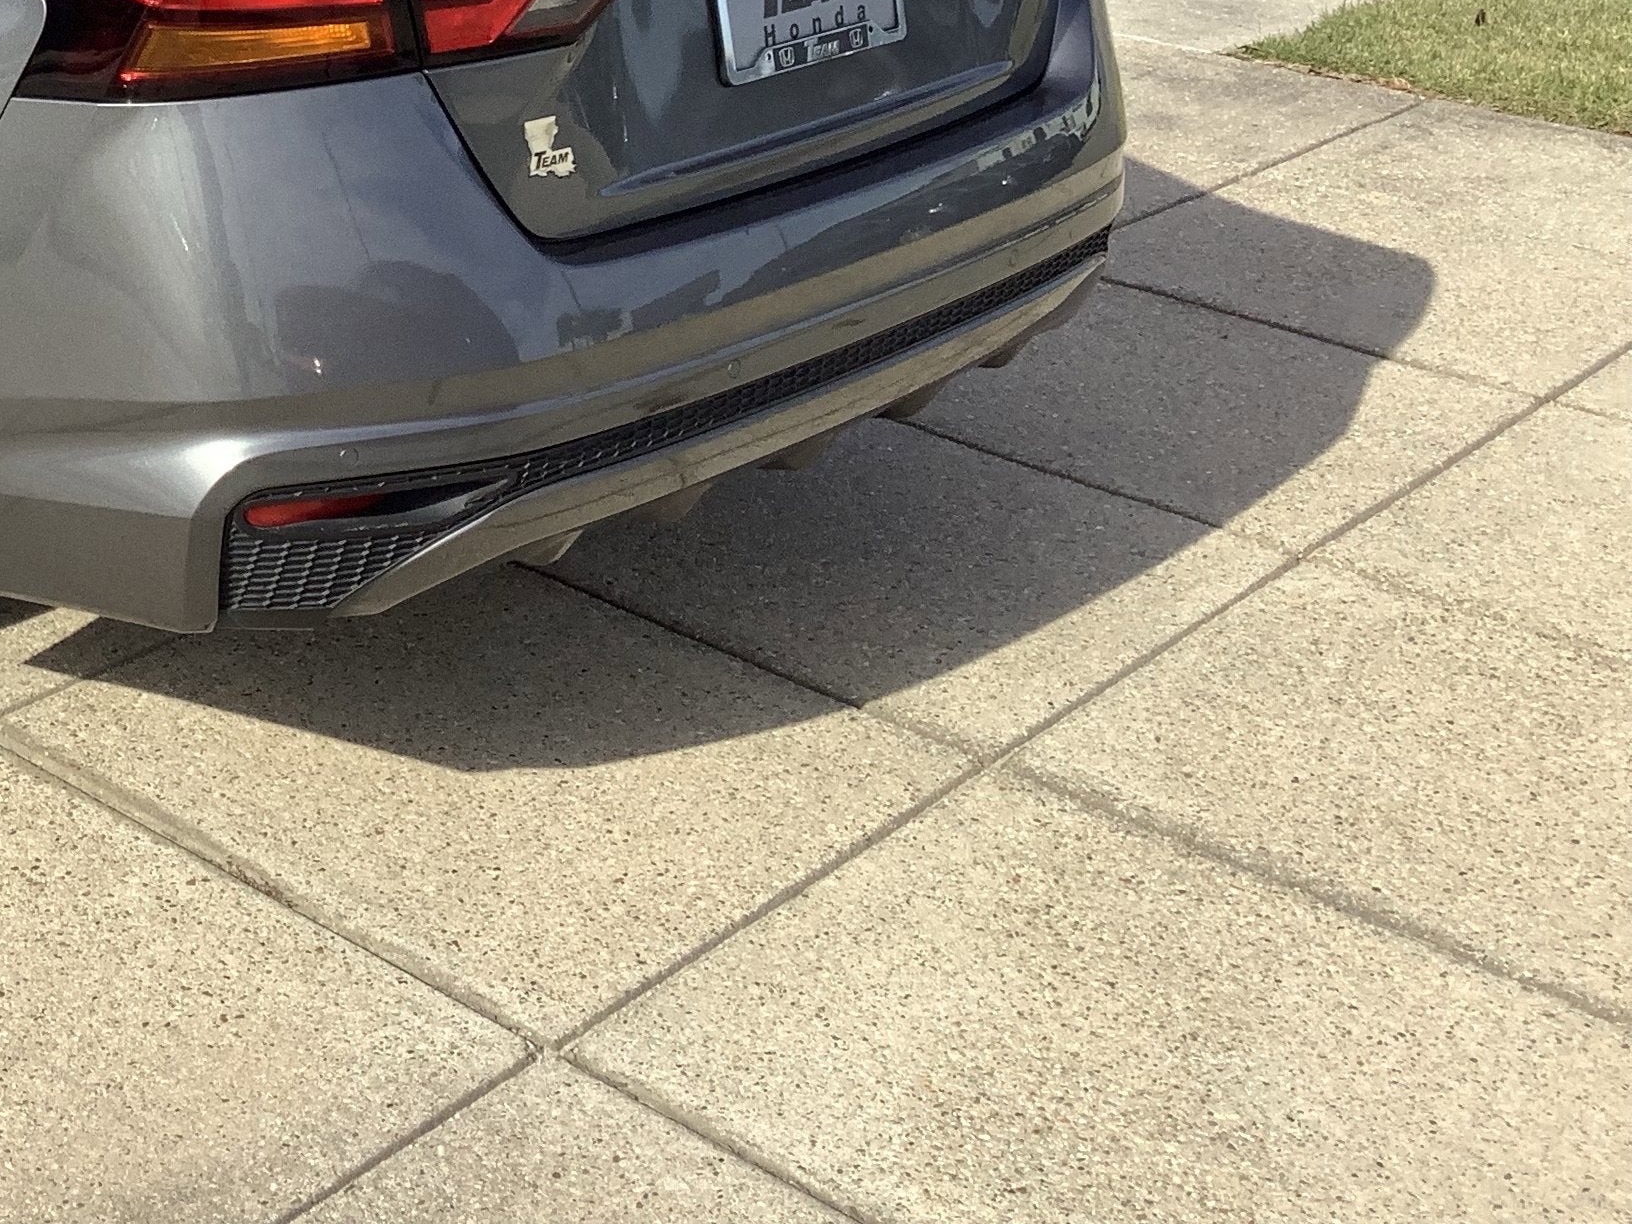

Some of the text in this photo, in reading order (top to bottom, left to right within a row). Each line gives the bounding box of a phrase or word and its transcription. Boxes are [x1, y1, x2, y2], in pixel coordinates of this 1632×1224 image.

[764, 4, 866, 47] Honda
[804, 37, 840, 62] TEAM
[534, 150, 569, 170] TEAM
